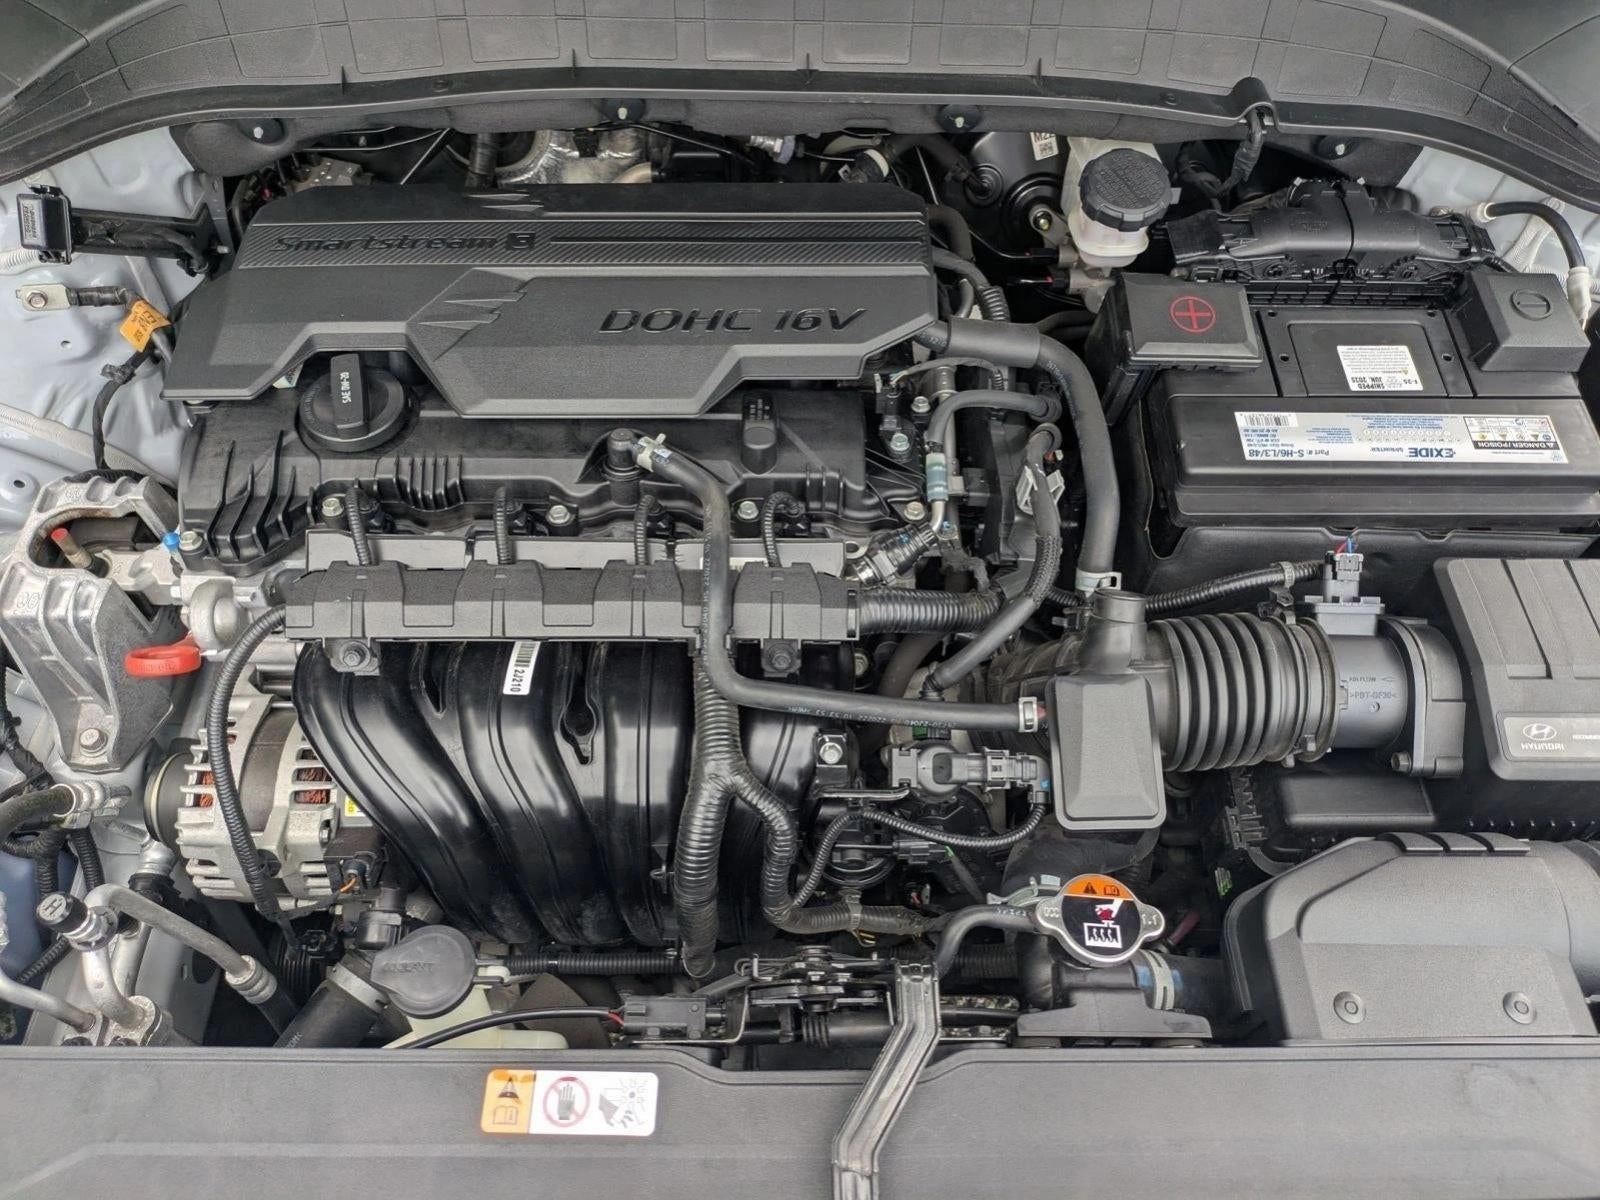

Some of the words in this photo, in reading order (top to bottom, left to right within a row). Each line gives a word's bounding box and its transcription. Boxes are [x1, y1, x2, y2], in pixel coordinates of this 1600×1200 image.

[270, 234, 498, 251] Smartstream
[599, 308, 761, 333] DOHC
[774, 308, 869, 333] 16V
[1513, 441, 1546, 449] DANGER
[1248, 449, 1305, 458] S-H6/L3/48
[1408, 447, 1457, 459] EXIDE
[1521, 742, 1566, 751] HYUNDAI
